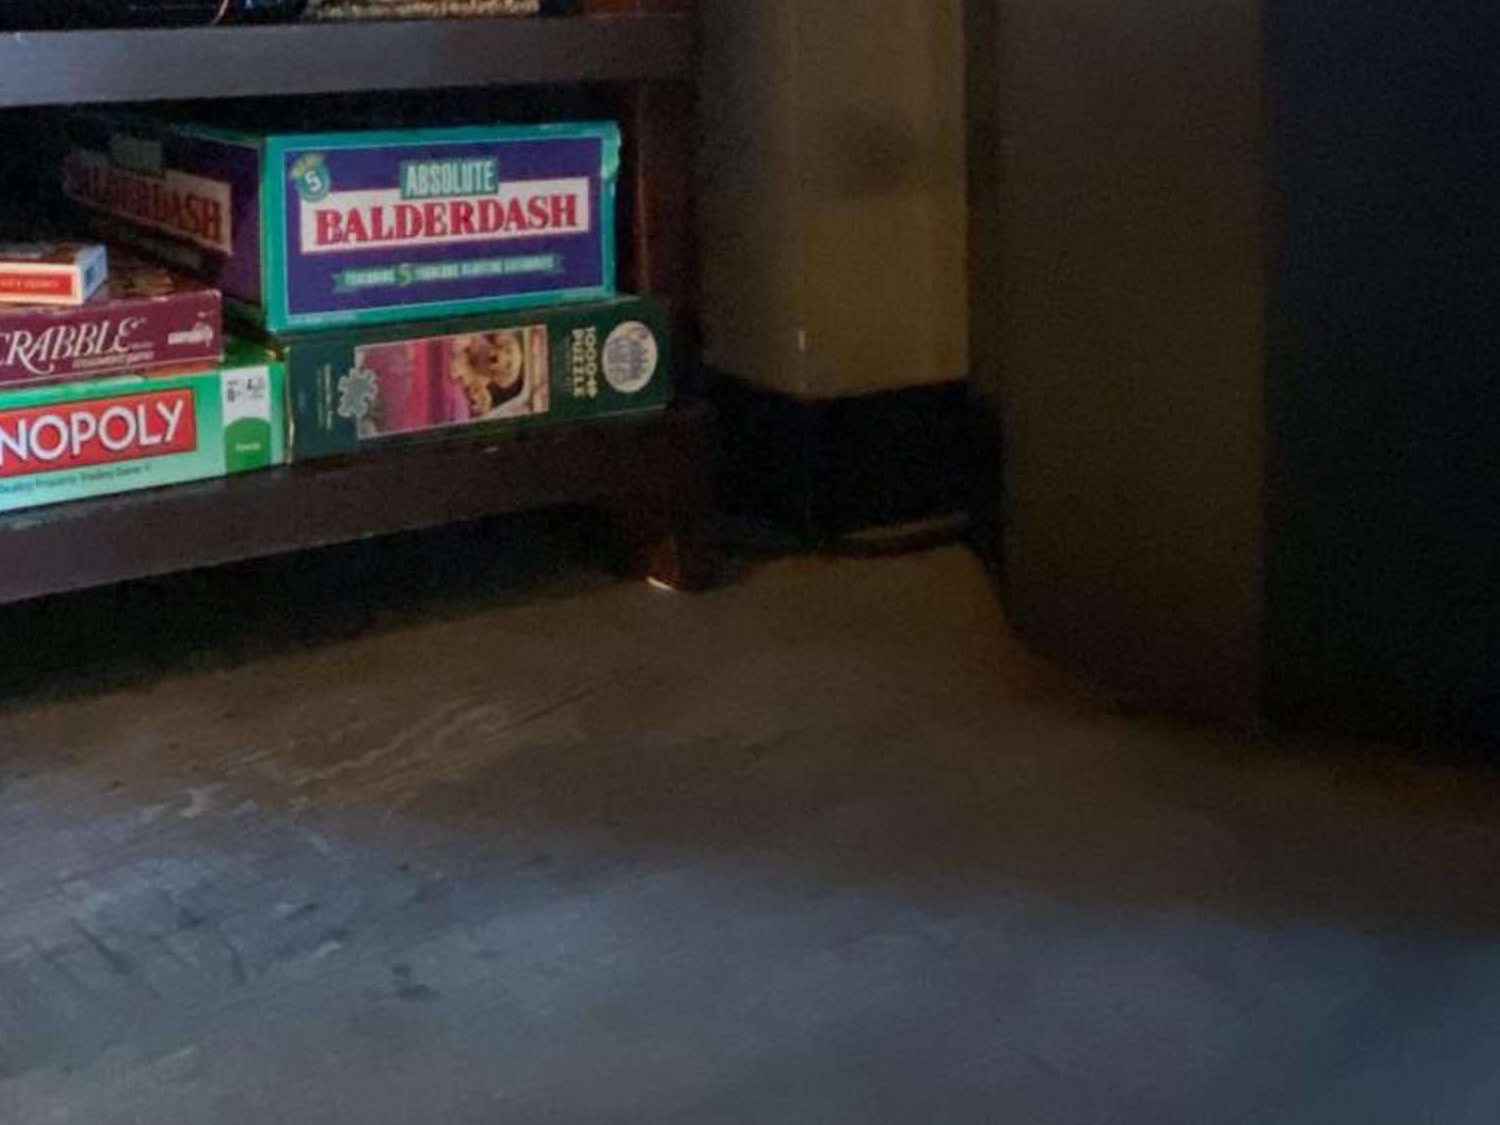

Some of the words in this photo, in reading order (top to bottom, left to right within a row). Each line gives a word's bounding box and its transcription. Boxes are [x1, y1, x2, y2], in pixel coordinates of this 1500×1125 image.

[405, 160, 495, 196] ABSOLUTE
[314, 193, 578, 246] BALDERDASH
[572, 328, 585, 397] PUZZLE
